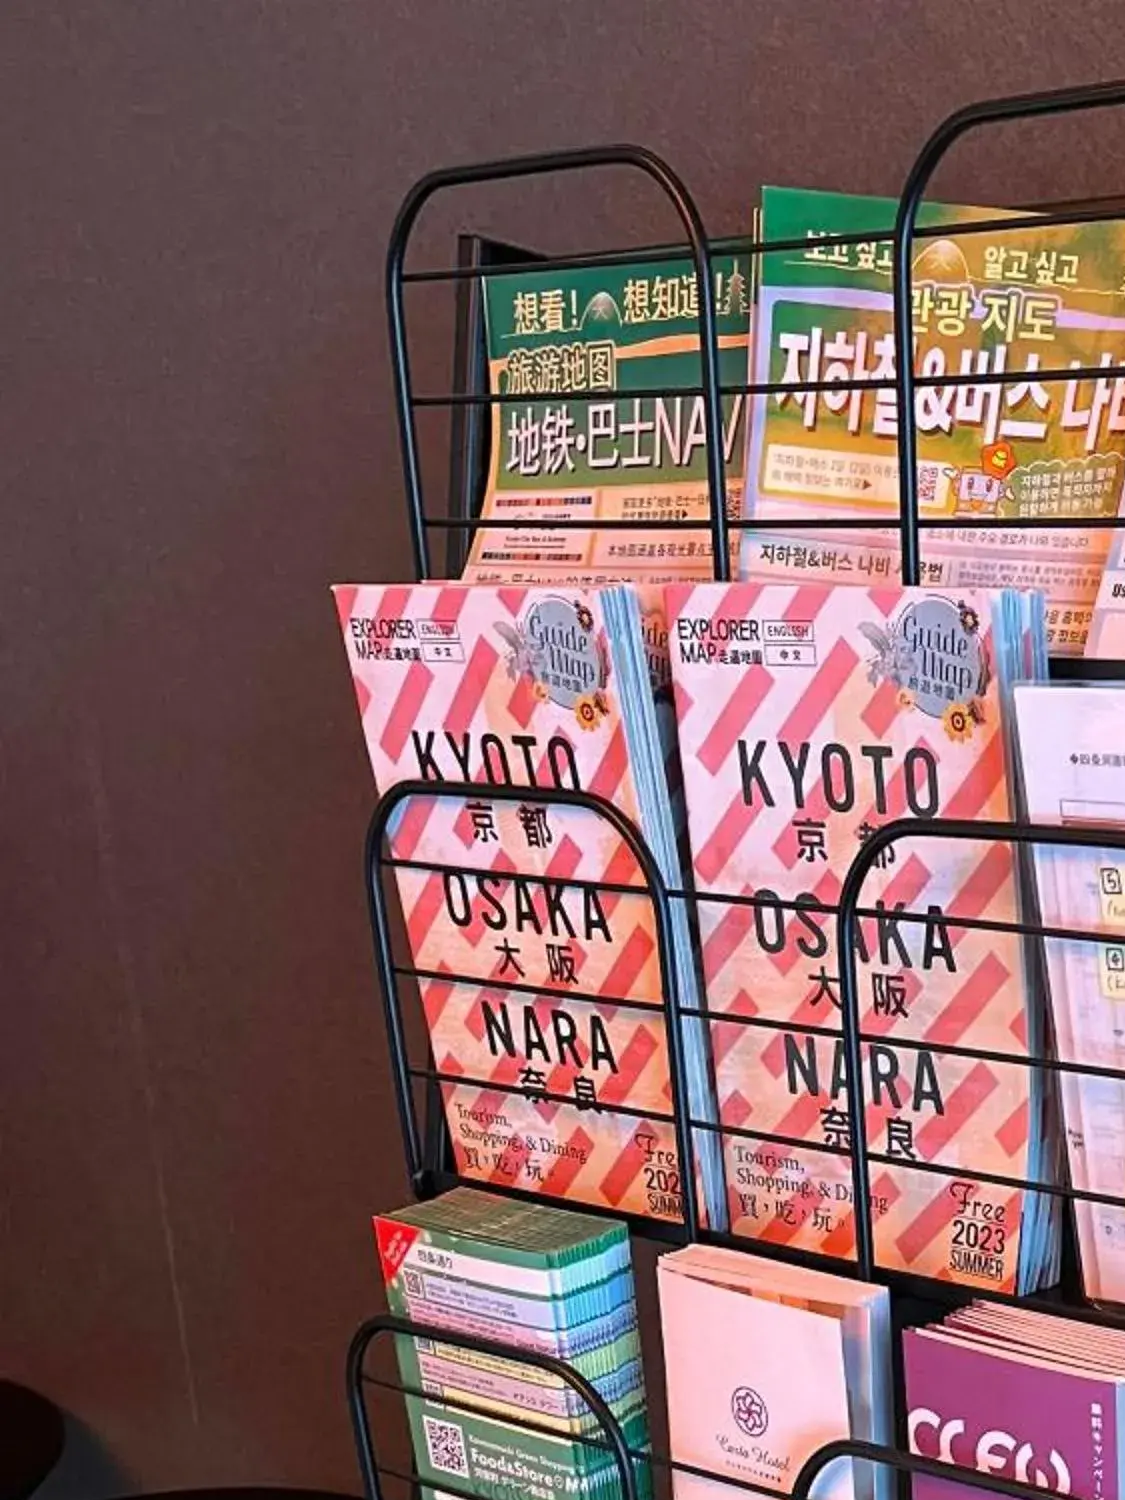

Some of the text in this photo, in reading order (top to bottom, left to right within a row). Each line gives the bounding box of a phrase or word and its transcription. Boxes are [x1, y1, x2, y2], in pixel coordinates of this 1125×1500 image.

[984, 246, 1080, 284] 알고 싶고
[513, 289, 580, 334] 想看!
[982, 294, 1057, 342] 지도
[508, 340, 618, 393] 旅游地图
[350, 618, 415, 639] EXPLORER
[529, 615, 587, 650] Guide
[677, 619, 761, 642] EXPLORER
[903, 615, 967, 658] Guide
[680, 641, 717, 665] MAP
[412, 730, 581, 794] KYOTO
[737, 739, 939, 818] KYOTO
[443, 869, 613, 943] OSAKA
[496, 938, 578, 985] 大阪
[808, 965, 909, 1019] 大阪
[481, 1000, 619, 1074] NARA
[539, 1137, 587, 1165] Dining
[734, 1145, 805, 1174] Tourism,
[950, 1181, 1006, 1223] Free
[951, 1220, 1006, 1255] 2023
[949, 1250, 1004, 1281] SUMMER
